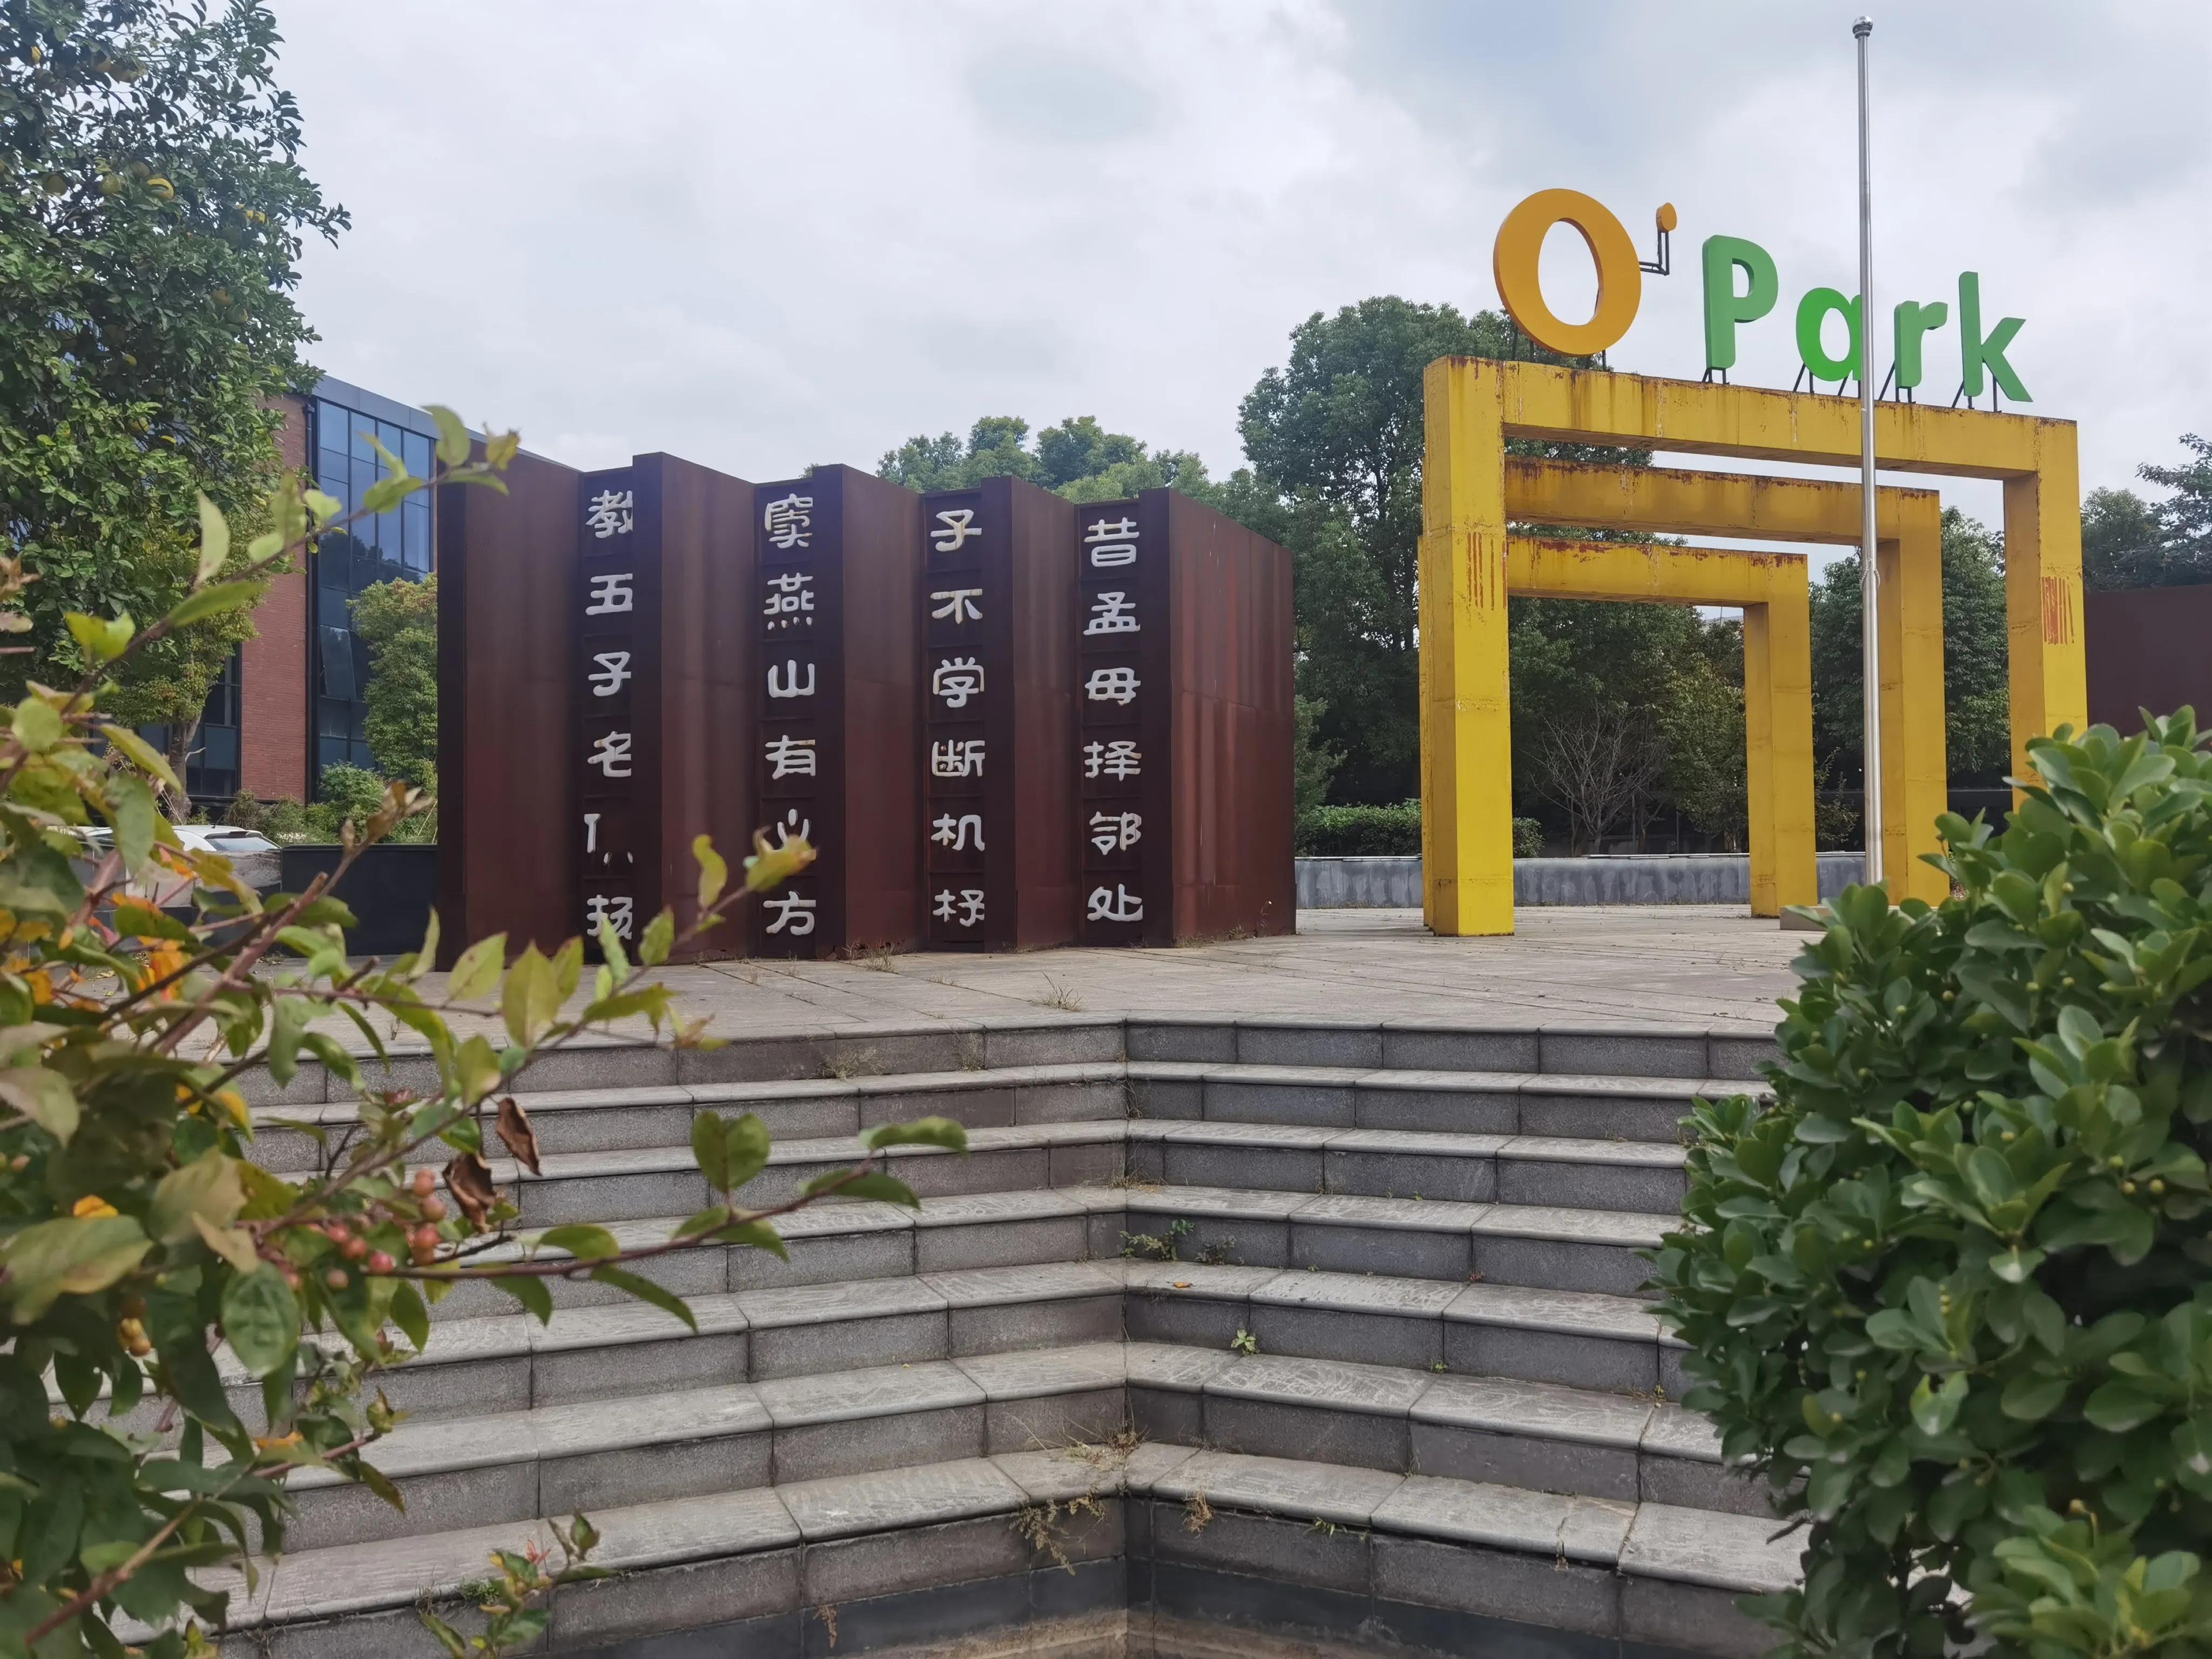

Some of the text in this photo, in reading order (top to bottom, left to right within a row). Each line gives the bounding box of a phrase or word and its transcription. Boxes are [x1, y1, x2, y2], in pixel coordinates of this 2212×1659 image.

[1083, 517, 1143, 922] 昔孟母择邻处
